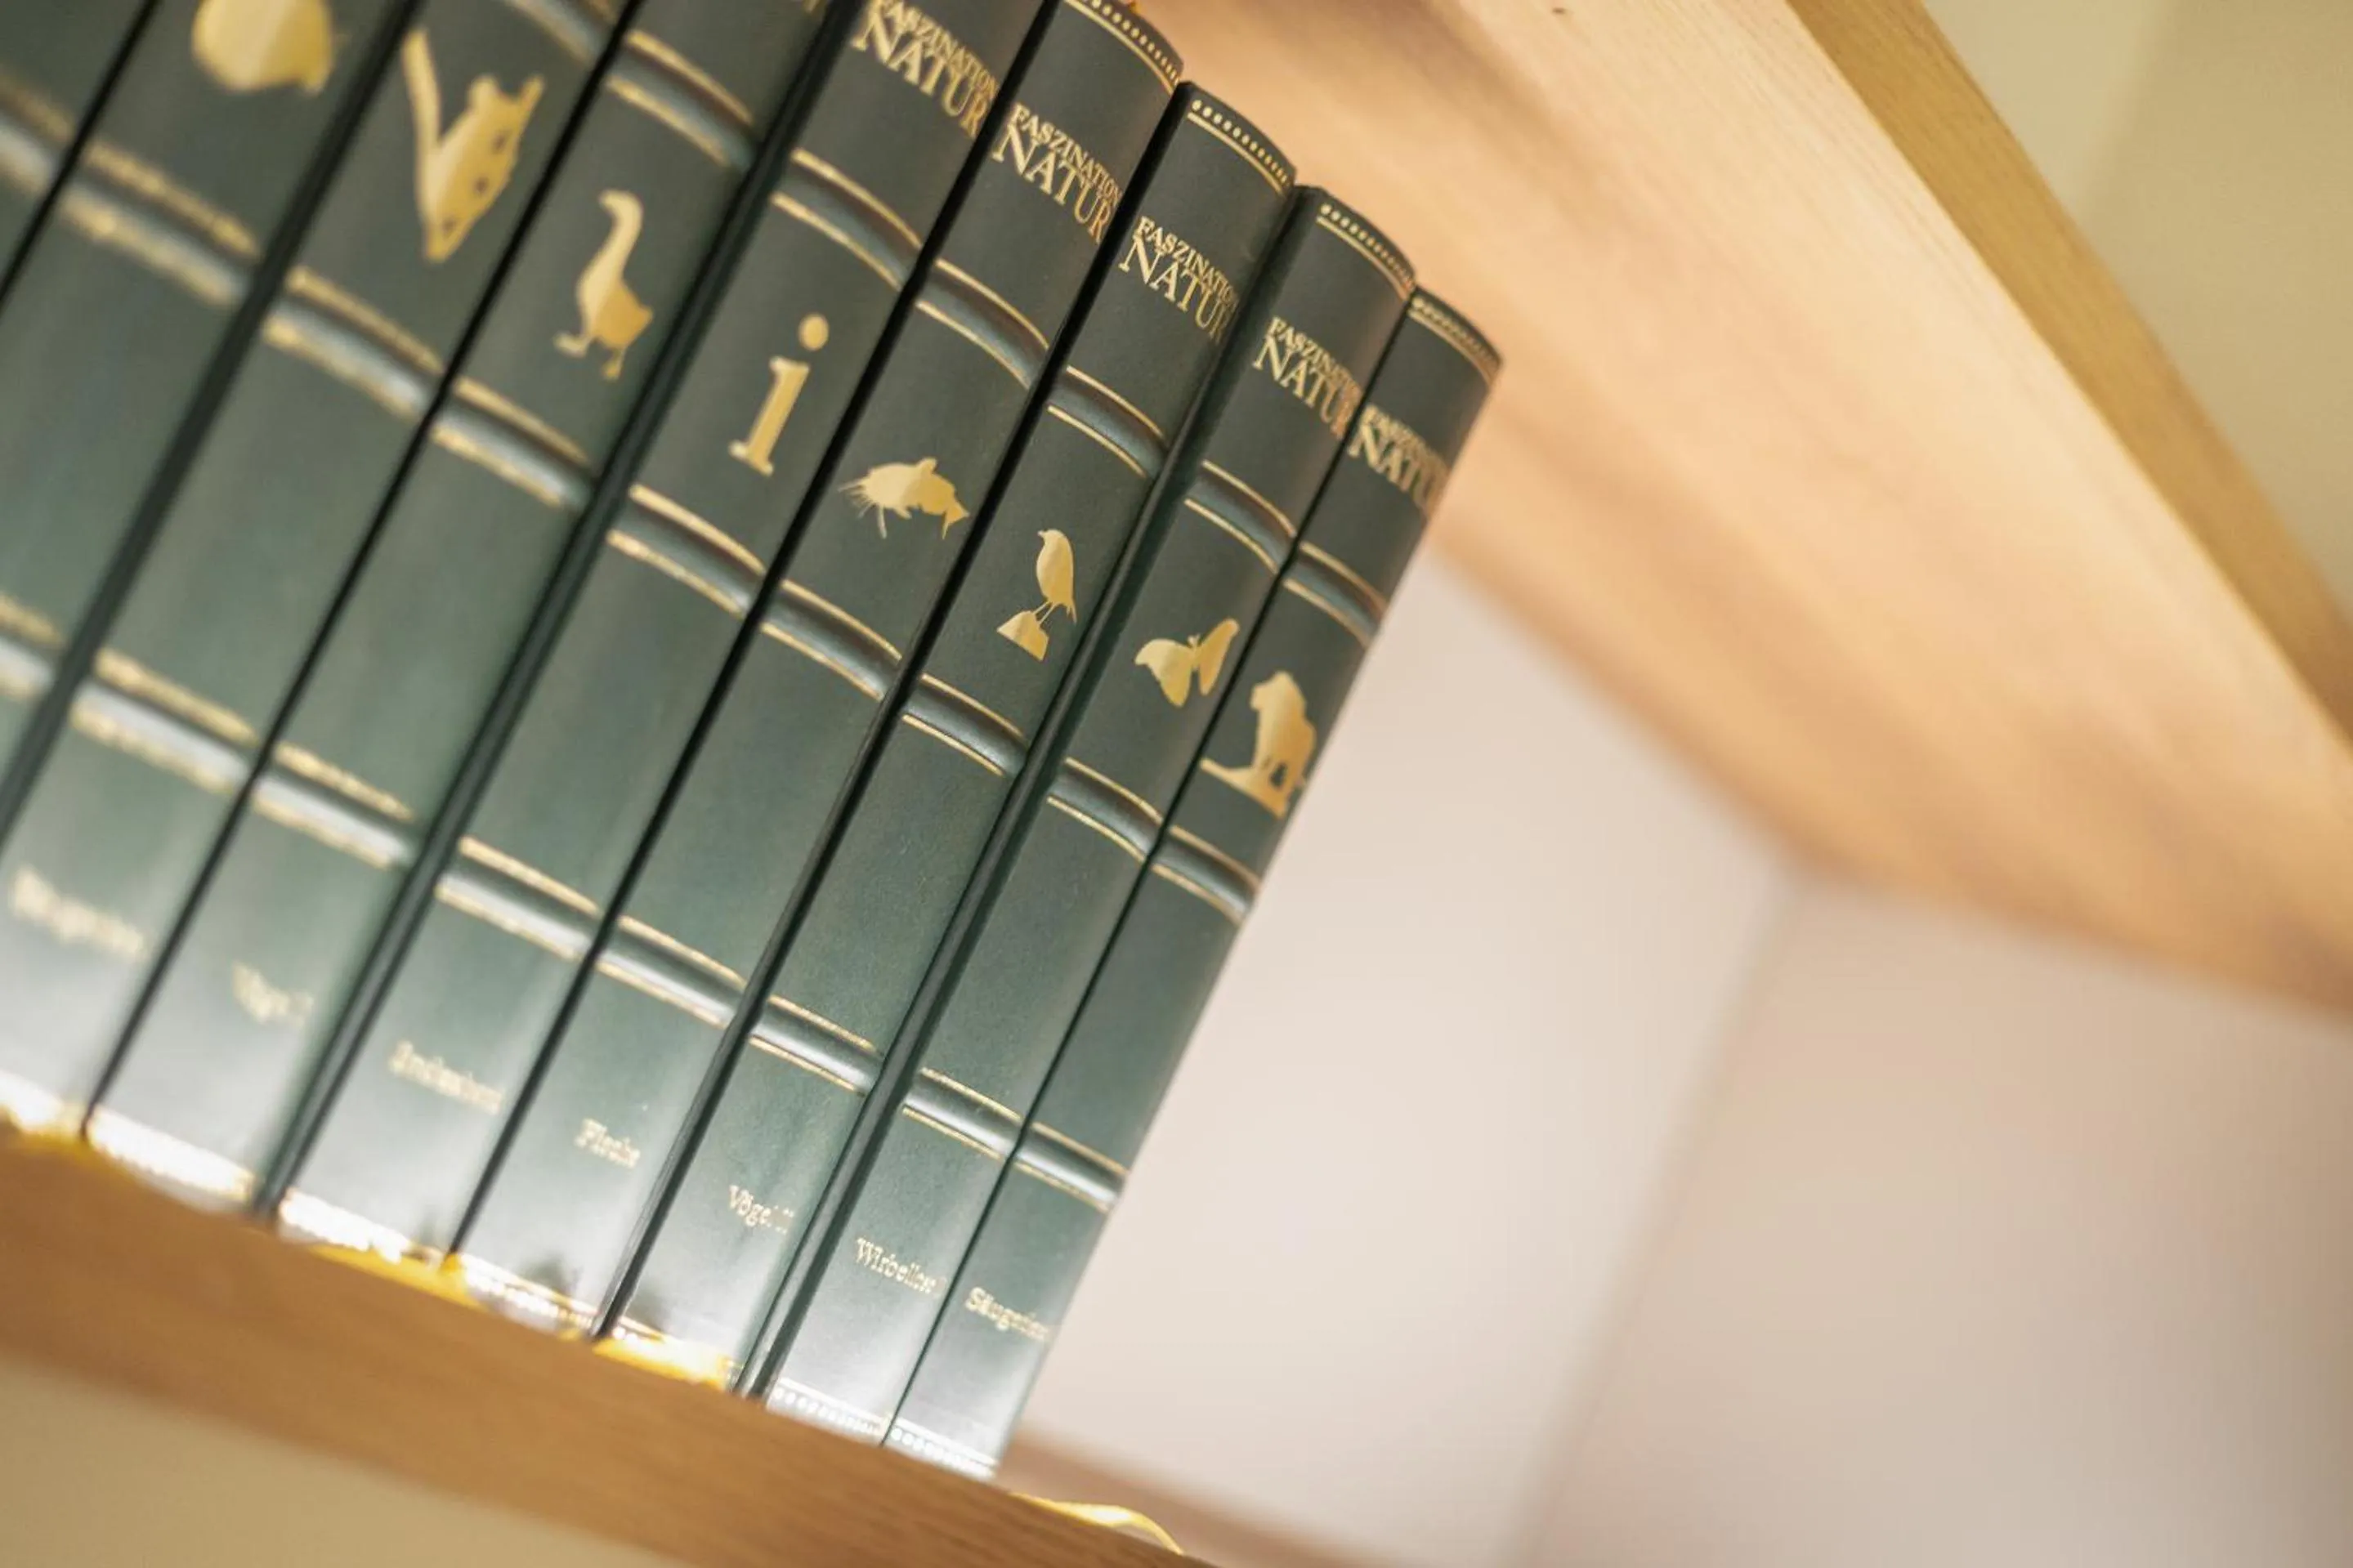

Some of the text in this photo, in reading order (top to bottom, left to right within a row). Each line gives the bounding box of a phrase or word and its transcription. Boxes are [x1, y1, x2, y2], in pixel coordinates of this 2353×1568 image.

[849, 8, 987, 141] NATUR
[991, 123, 1111, 245] NATUR
[1010, 103, 1123, 208] FASZINATION
